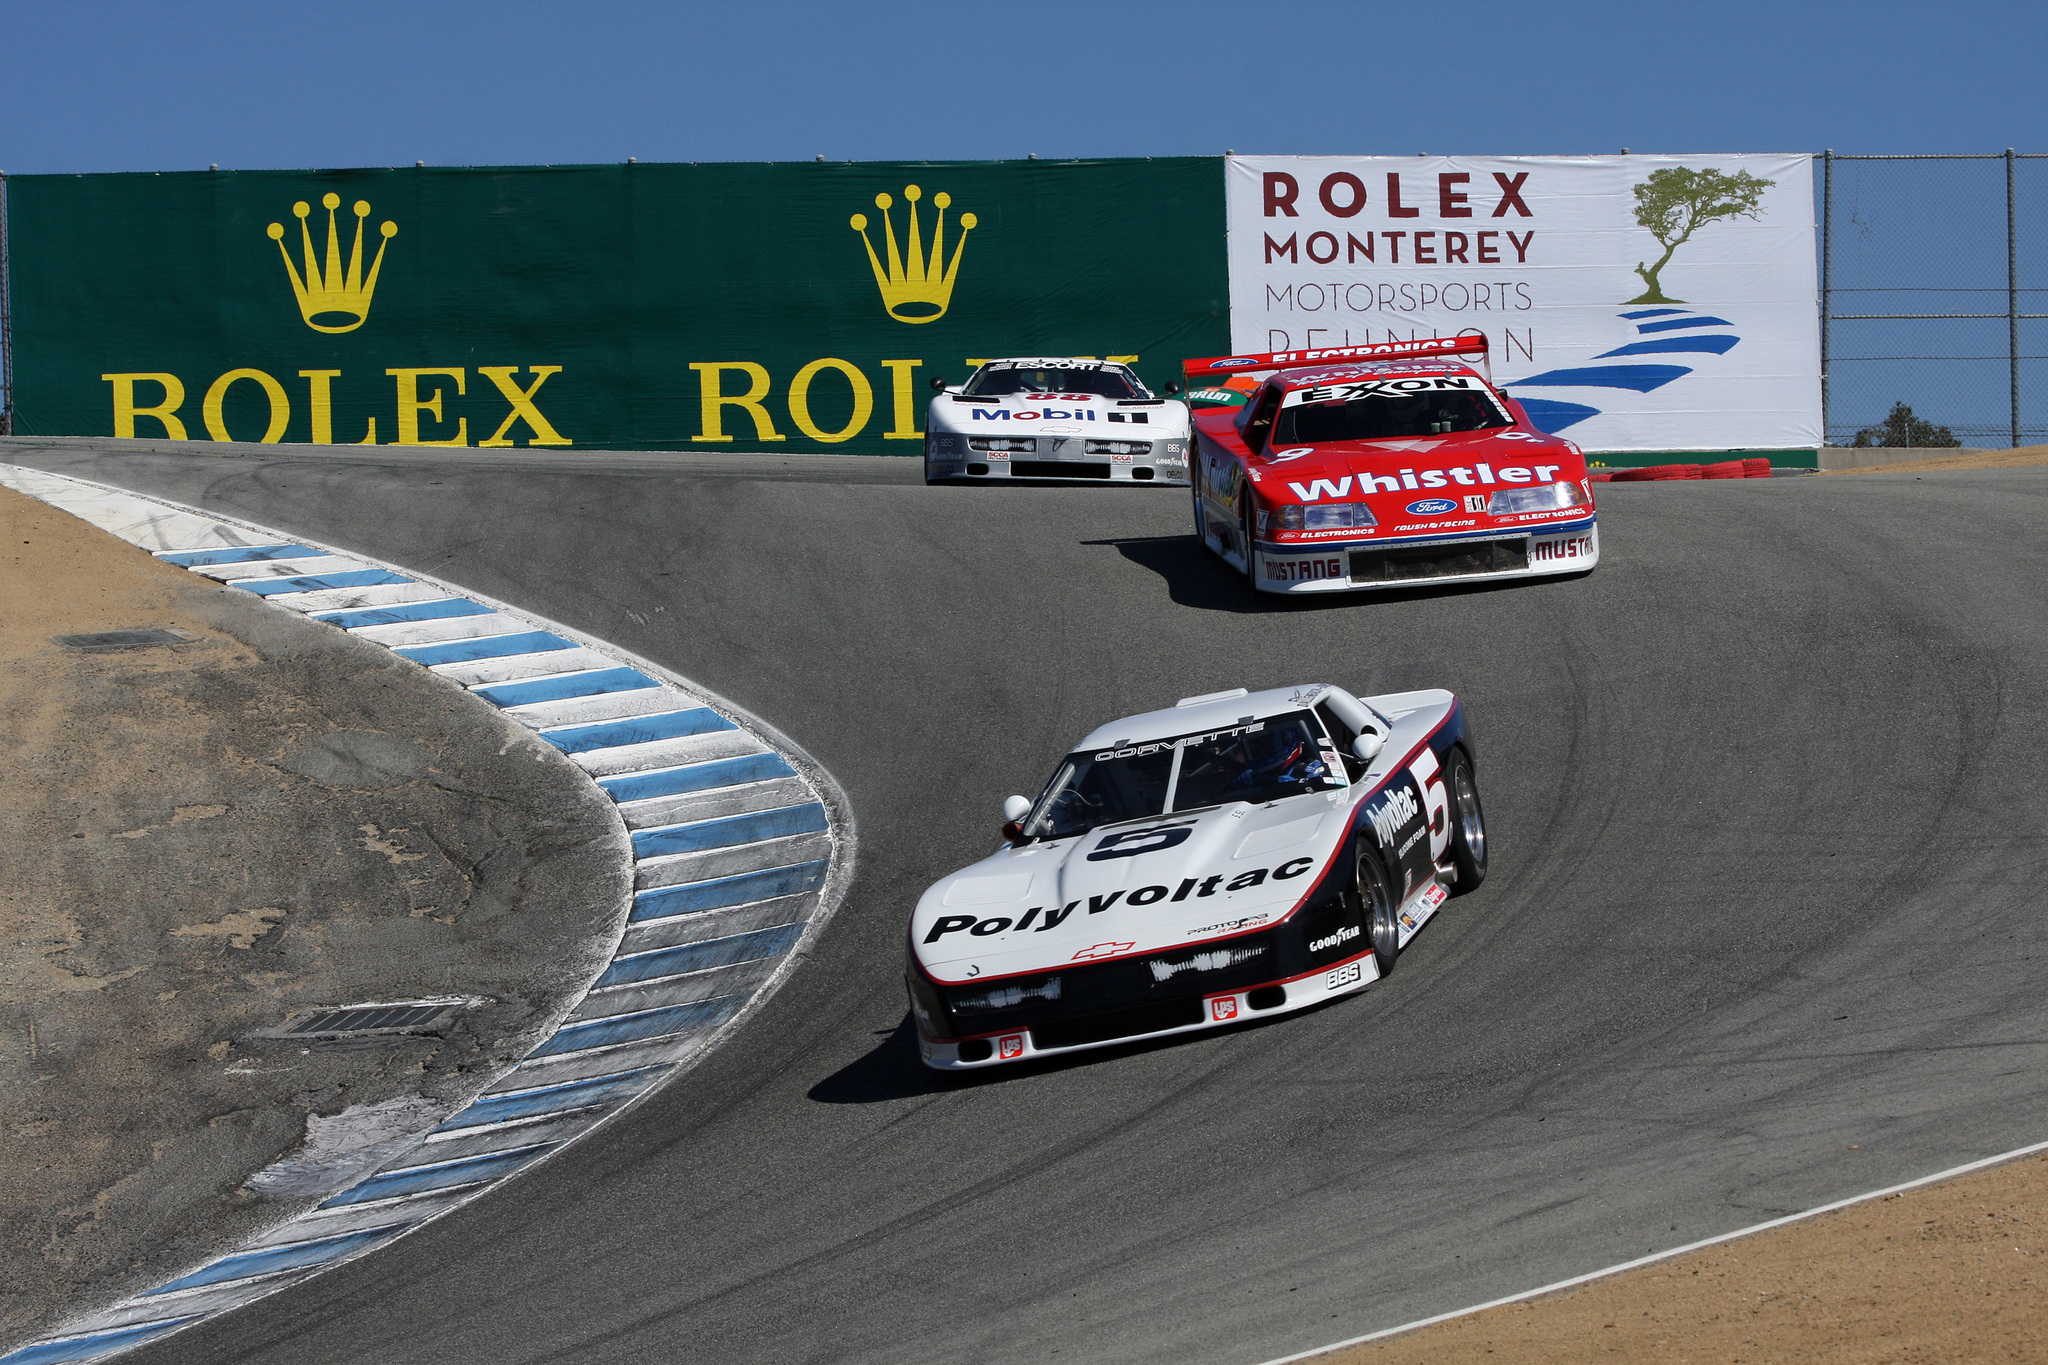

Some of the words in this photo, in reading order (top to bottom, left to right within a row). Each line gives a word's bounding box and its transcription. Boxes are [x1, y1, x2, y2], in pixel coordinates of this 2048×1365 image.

[1262, 171, 1534, 219] ROLEX
[1263, 230, 1535, 265] MONTEREY
[1266, 282, 1533, 312] MOTORSPORTS
[1014, 361, 1100, 371] ESCORT
[688, 355, 1138, 443] ROL
[1025, 392, 1094, 402] 88
[1301, 378, 1470, 403] EXXON
[101, 365, 573, 446] ROLEX
[972, 408, 1096, 421] Mobil
[1118, 412, 1134, 423] 1
[1167, 443, 1180, 453] BBS
[1266, 447, 1316, 465] 9
[1287, 462, 1562, 502] Whistler
[1414, 500, 1450, 514] Ford
[1518, 507, 1586, 521] ELECTRONICS
[1300, 528, 1375, 539] ELECTRONICS
[1265, 558, 1341, 581] MUSTANG
[1094, 721, 1265, 762] CORVETTE
[1366, 785, 1418, 849] Polyvoltac
[1408, 746, 1450, 862] 5
[1086, 819, 1199, 862] 5
[1412, 824, 1427, 844] FOAM
[923, 856, 1314, 945] Polyvoltac
[1309, 925, 1361, 952] GOODYEAR
[1326, 962, 1361, 990] BBS
[1213, 1000, 1236, 1016] LPS
[1001, 1038, 1021, 1055] LPS
